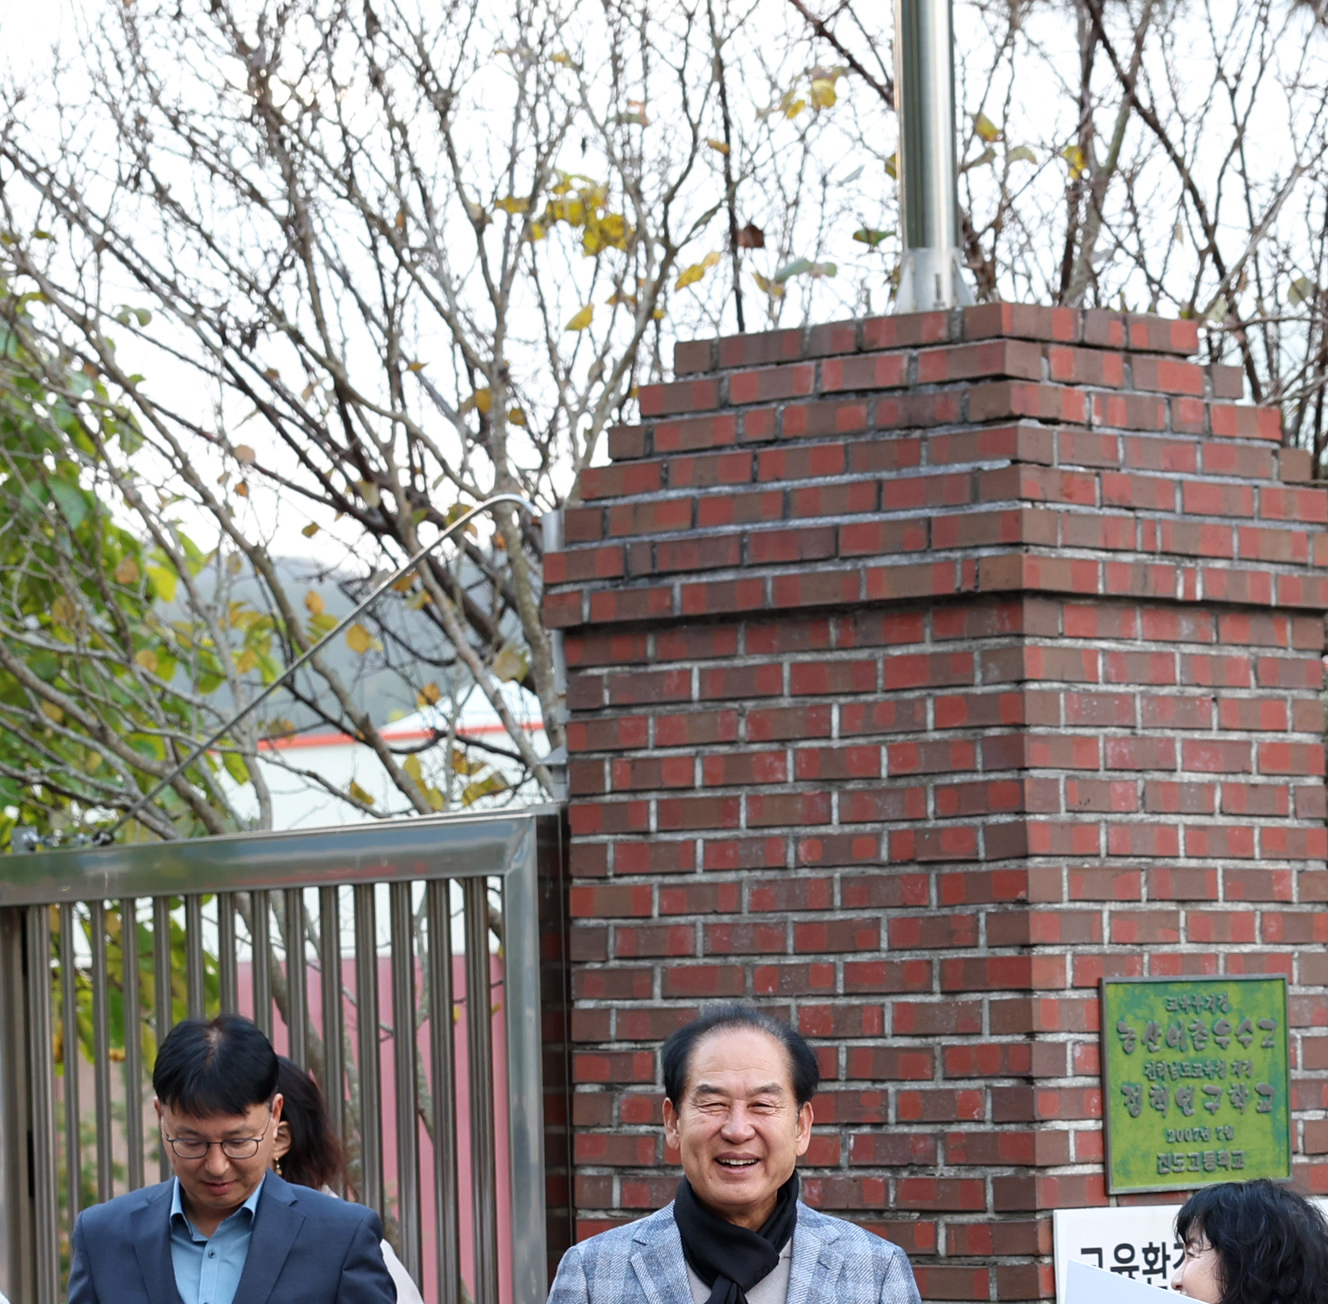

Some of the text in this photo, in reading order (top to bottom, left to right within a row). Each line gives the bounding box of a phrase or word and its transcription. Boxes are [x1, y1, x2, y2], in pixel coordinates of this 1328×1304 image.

[1117, 1018, 1278, 1055] 농산어촌우수고
[1144, 1059, 1254, 1081] 전라남도교육청 지정
[1157, 1150, 1246, 1175] 진도고등학교
